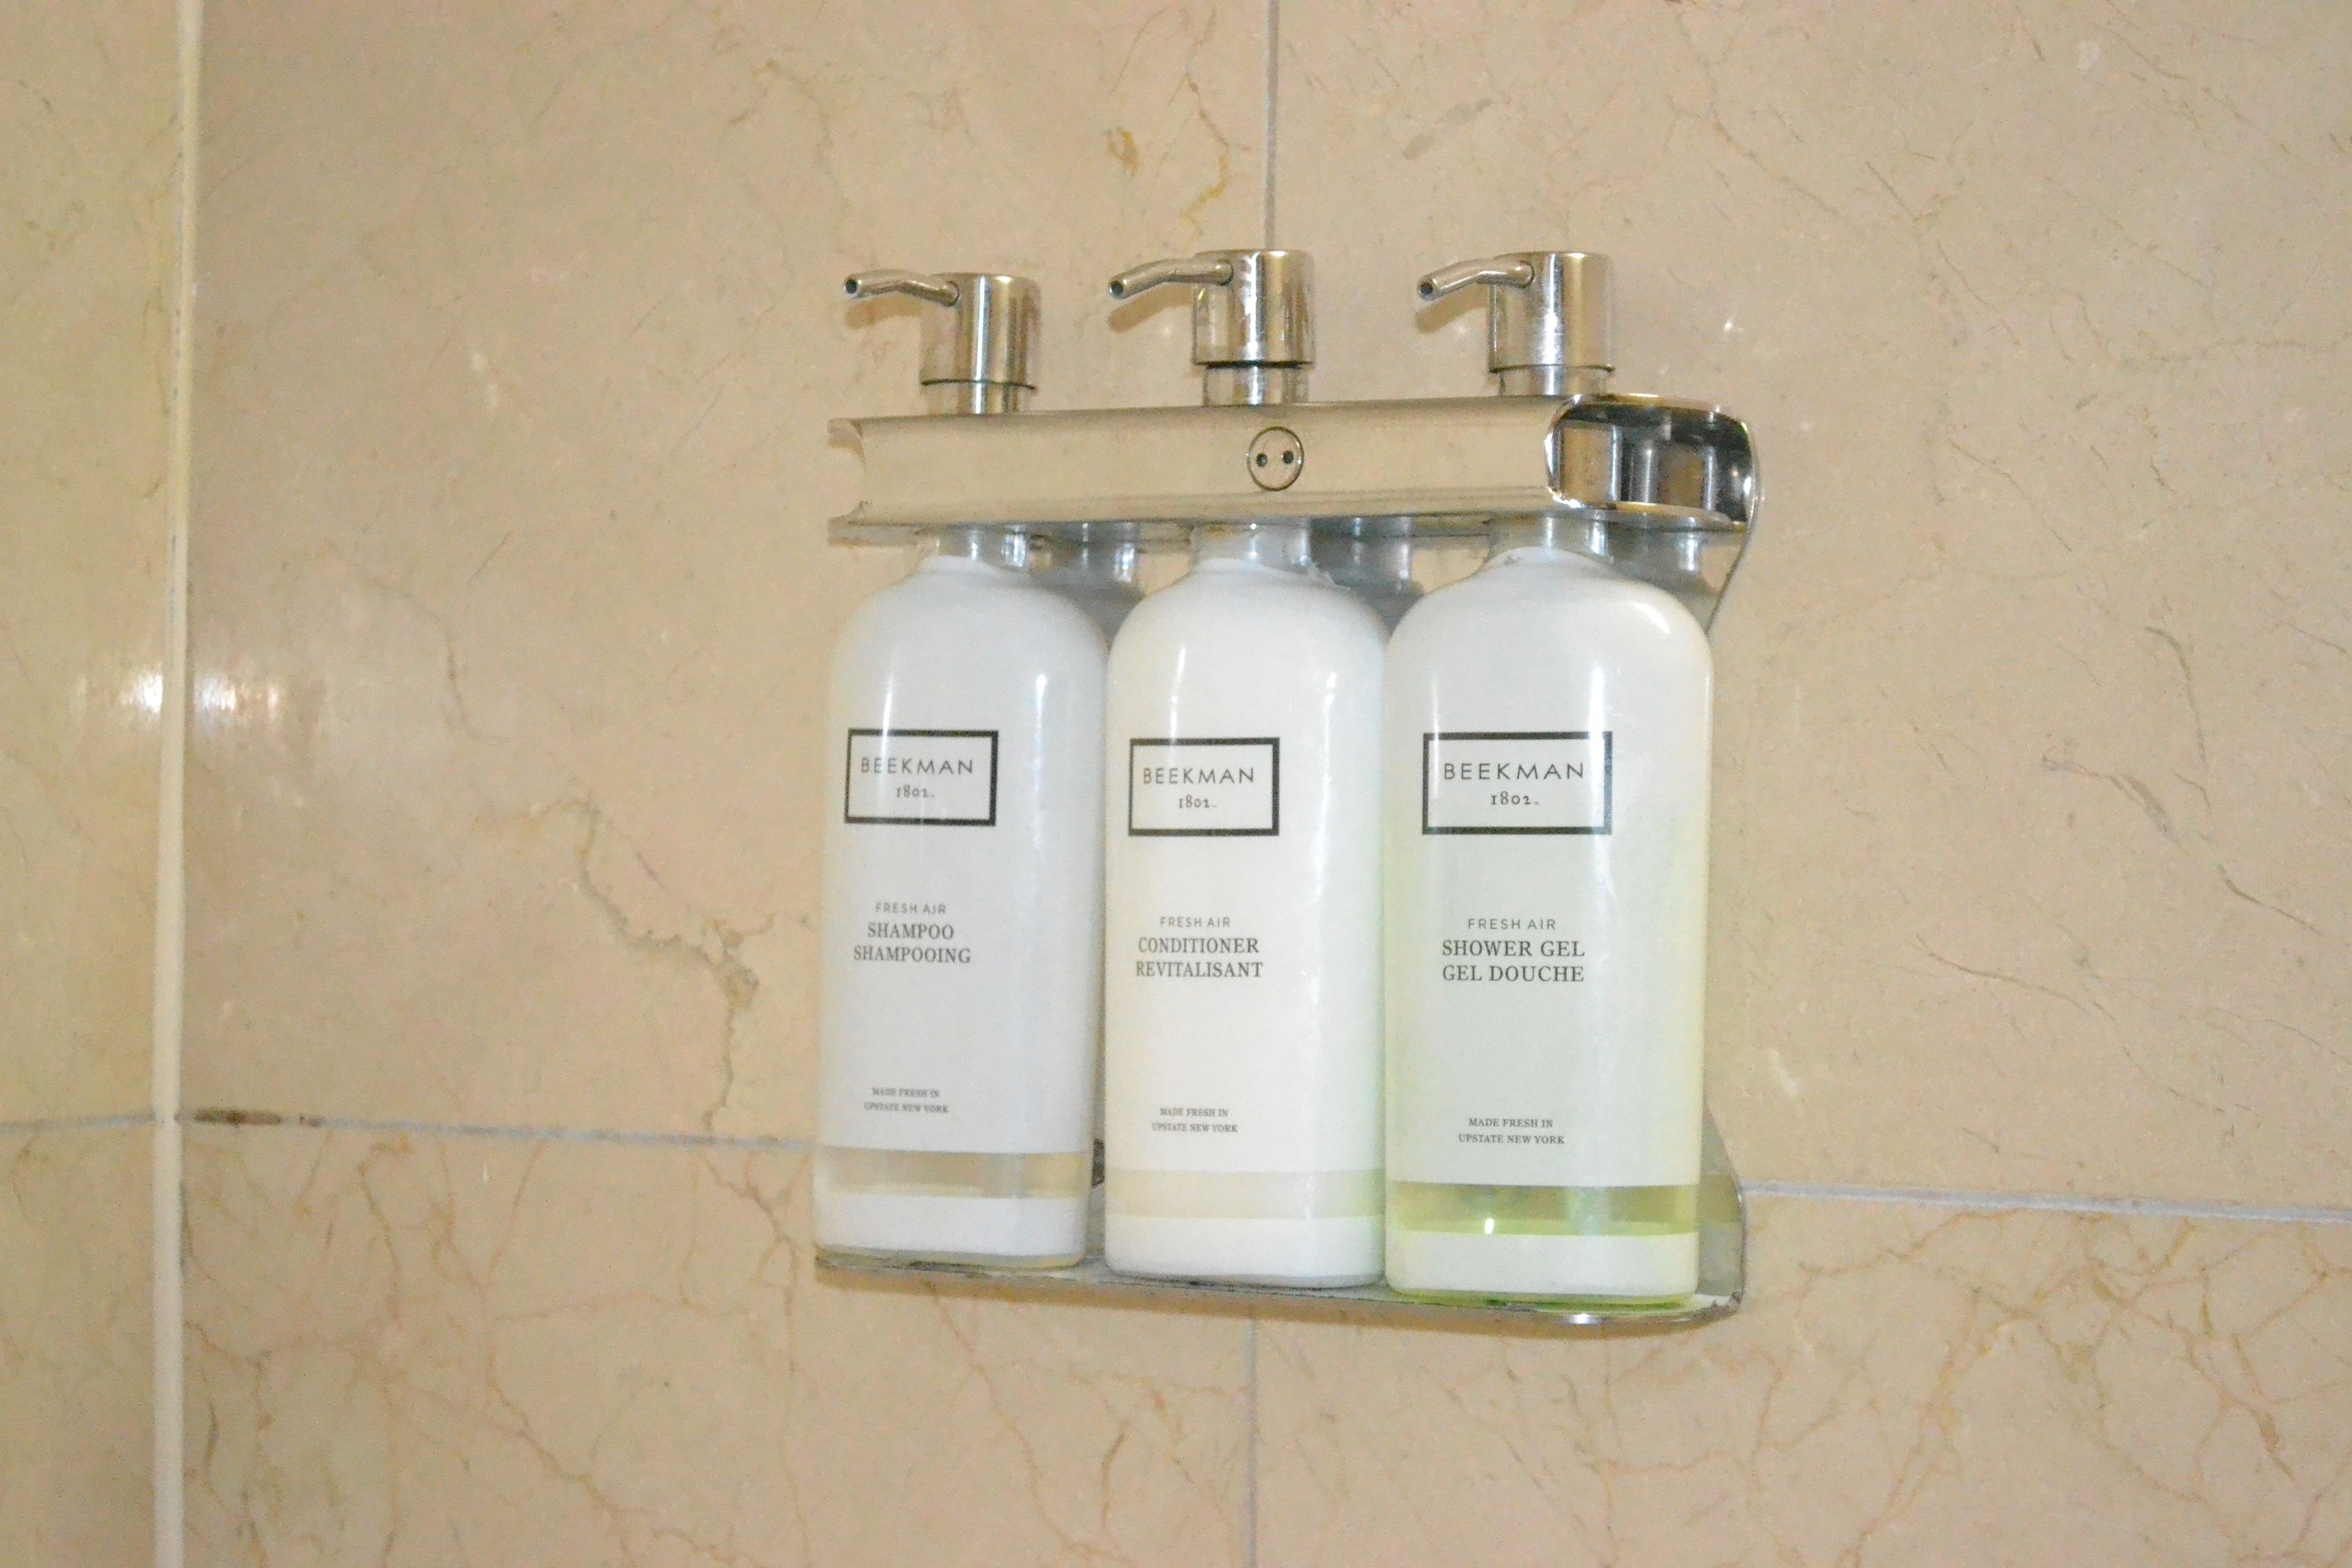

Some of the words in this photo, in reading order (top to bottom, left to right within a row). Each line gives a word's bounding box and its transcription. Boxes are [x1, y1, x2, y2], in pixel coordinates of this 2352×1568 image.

[861, 757, 973, 774] BEEKMAN
[1444, 763, 1583, 780] BEEKMAN
[1143, 767, 1254, 784] BEEKMAN
[875, 902, 918, 914] FRESH
[923, 903, 946, 914] AIR
[867, 921, 954, 940] SHAMPOO
[1160, 917, 1202, 927] FRESH
[1207, 918, 1231, 927] AIR
[1468, 919, 1520, 930] FRESH
[1528, 919, 1556, 930] AIR
[853, 945, 971, 963] SHAMPOOING
[1138, 937, 1259, 954] CONDITIONER
[1442, 940, 1532, 957] SHOWER
[1540, 941, 1585, 957] GEL
[1136, 961, 1263, 978] REVITALISANT
[1442, 965, 1482, 981] GEL
[1489, 965, 1585, 982] DOUCHE
[1186, 1108, 1215, 1117] FRESH
[1152, 1123, 1187, 1132] UPSTATE
[1189, 1123, 1210, 1132] NEW
[1502, 1119, 1537, 1128] FRESH
[1542, 1119, 1553, 1128] IN
[1458, 1134, 1504, 1143] UPSTATE
[1507, 1135, 1531, 1144] NEW
[1534, 1136, 1564, 1144] YORK
